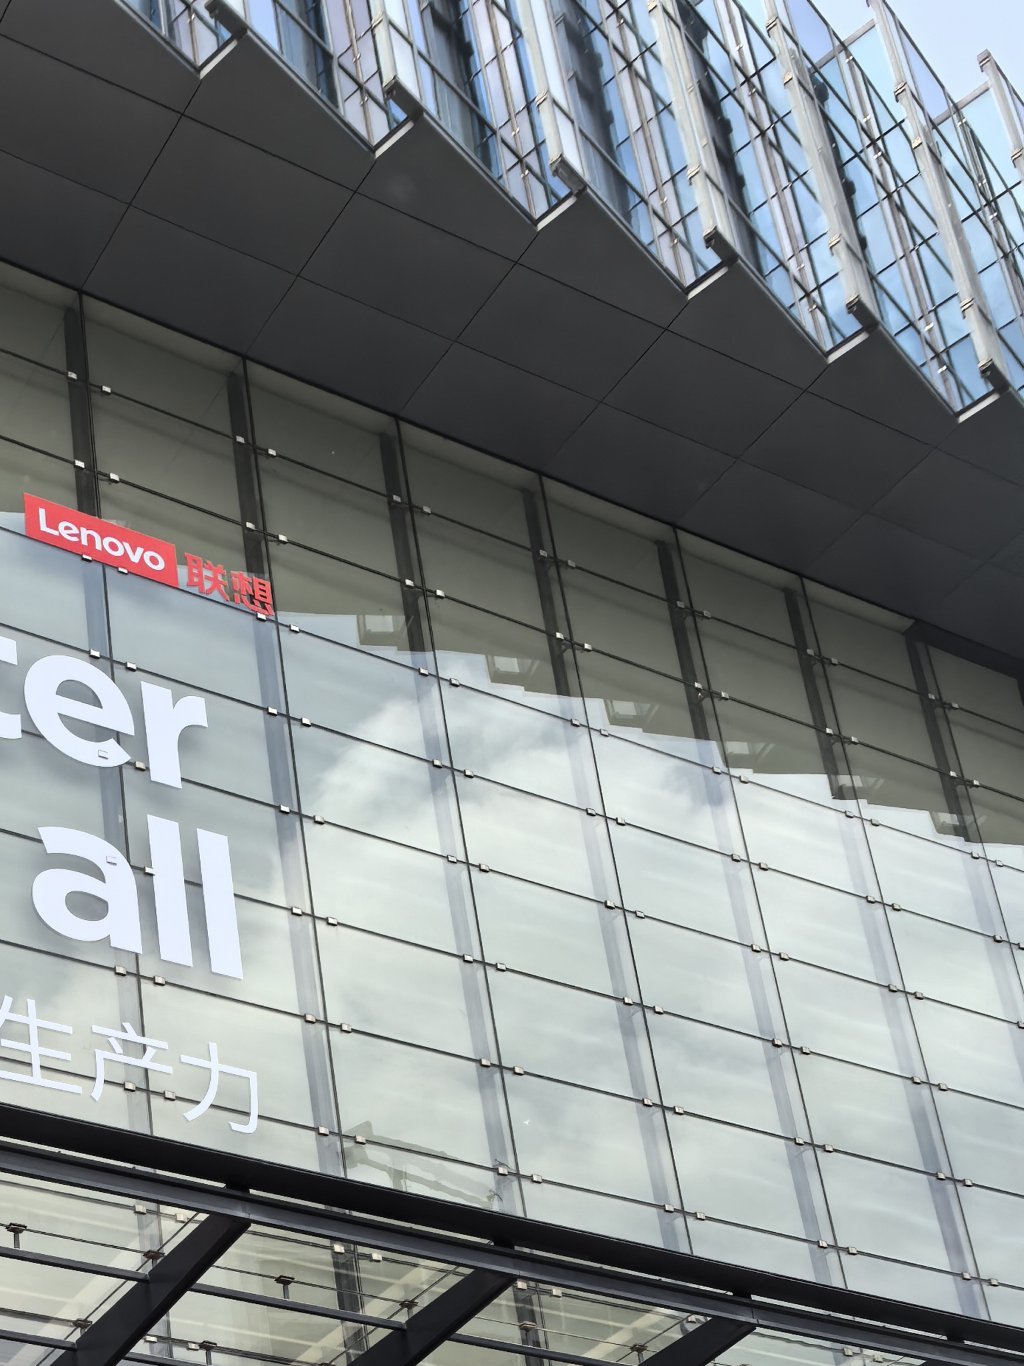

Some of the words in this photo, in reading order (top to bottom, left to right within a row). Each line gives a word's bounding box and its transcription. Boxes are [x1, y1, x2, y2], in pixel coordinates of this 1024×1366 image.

[38, 507, 165, 571] Lenovo
[184, 551, 275, 617] 联想
[31, 815, 244, 980] all
